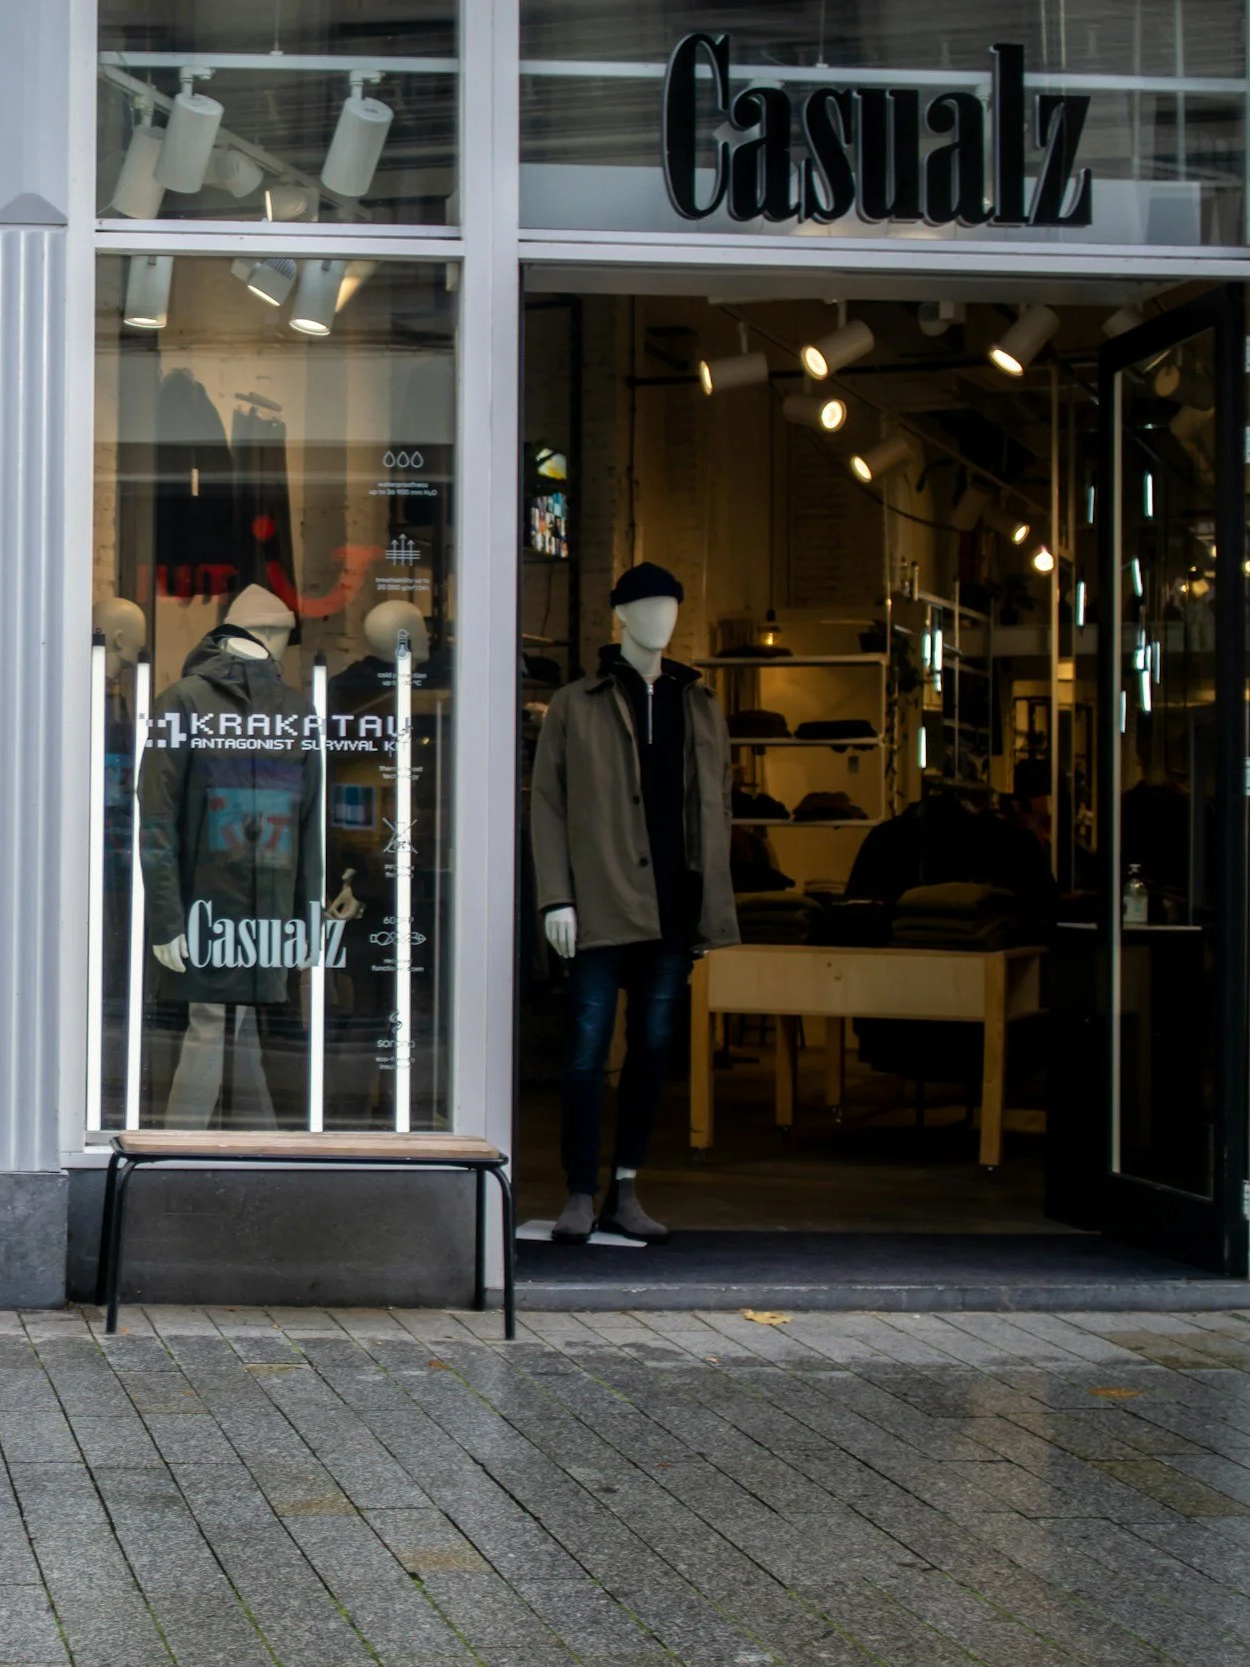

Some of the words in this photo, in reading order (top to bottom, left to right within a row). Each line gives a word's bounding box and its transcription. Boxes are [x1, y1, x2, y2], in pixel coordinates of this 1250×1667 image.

[662, 33, 1093, 227] Casualz
[190, 712, 409, 737] KRAKATAU
[190, 738, 295, 751] ANTAGONIST
[301, 739, 378, 751] SURVIVAL
[187, 900, 347, 969] Casualz
